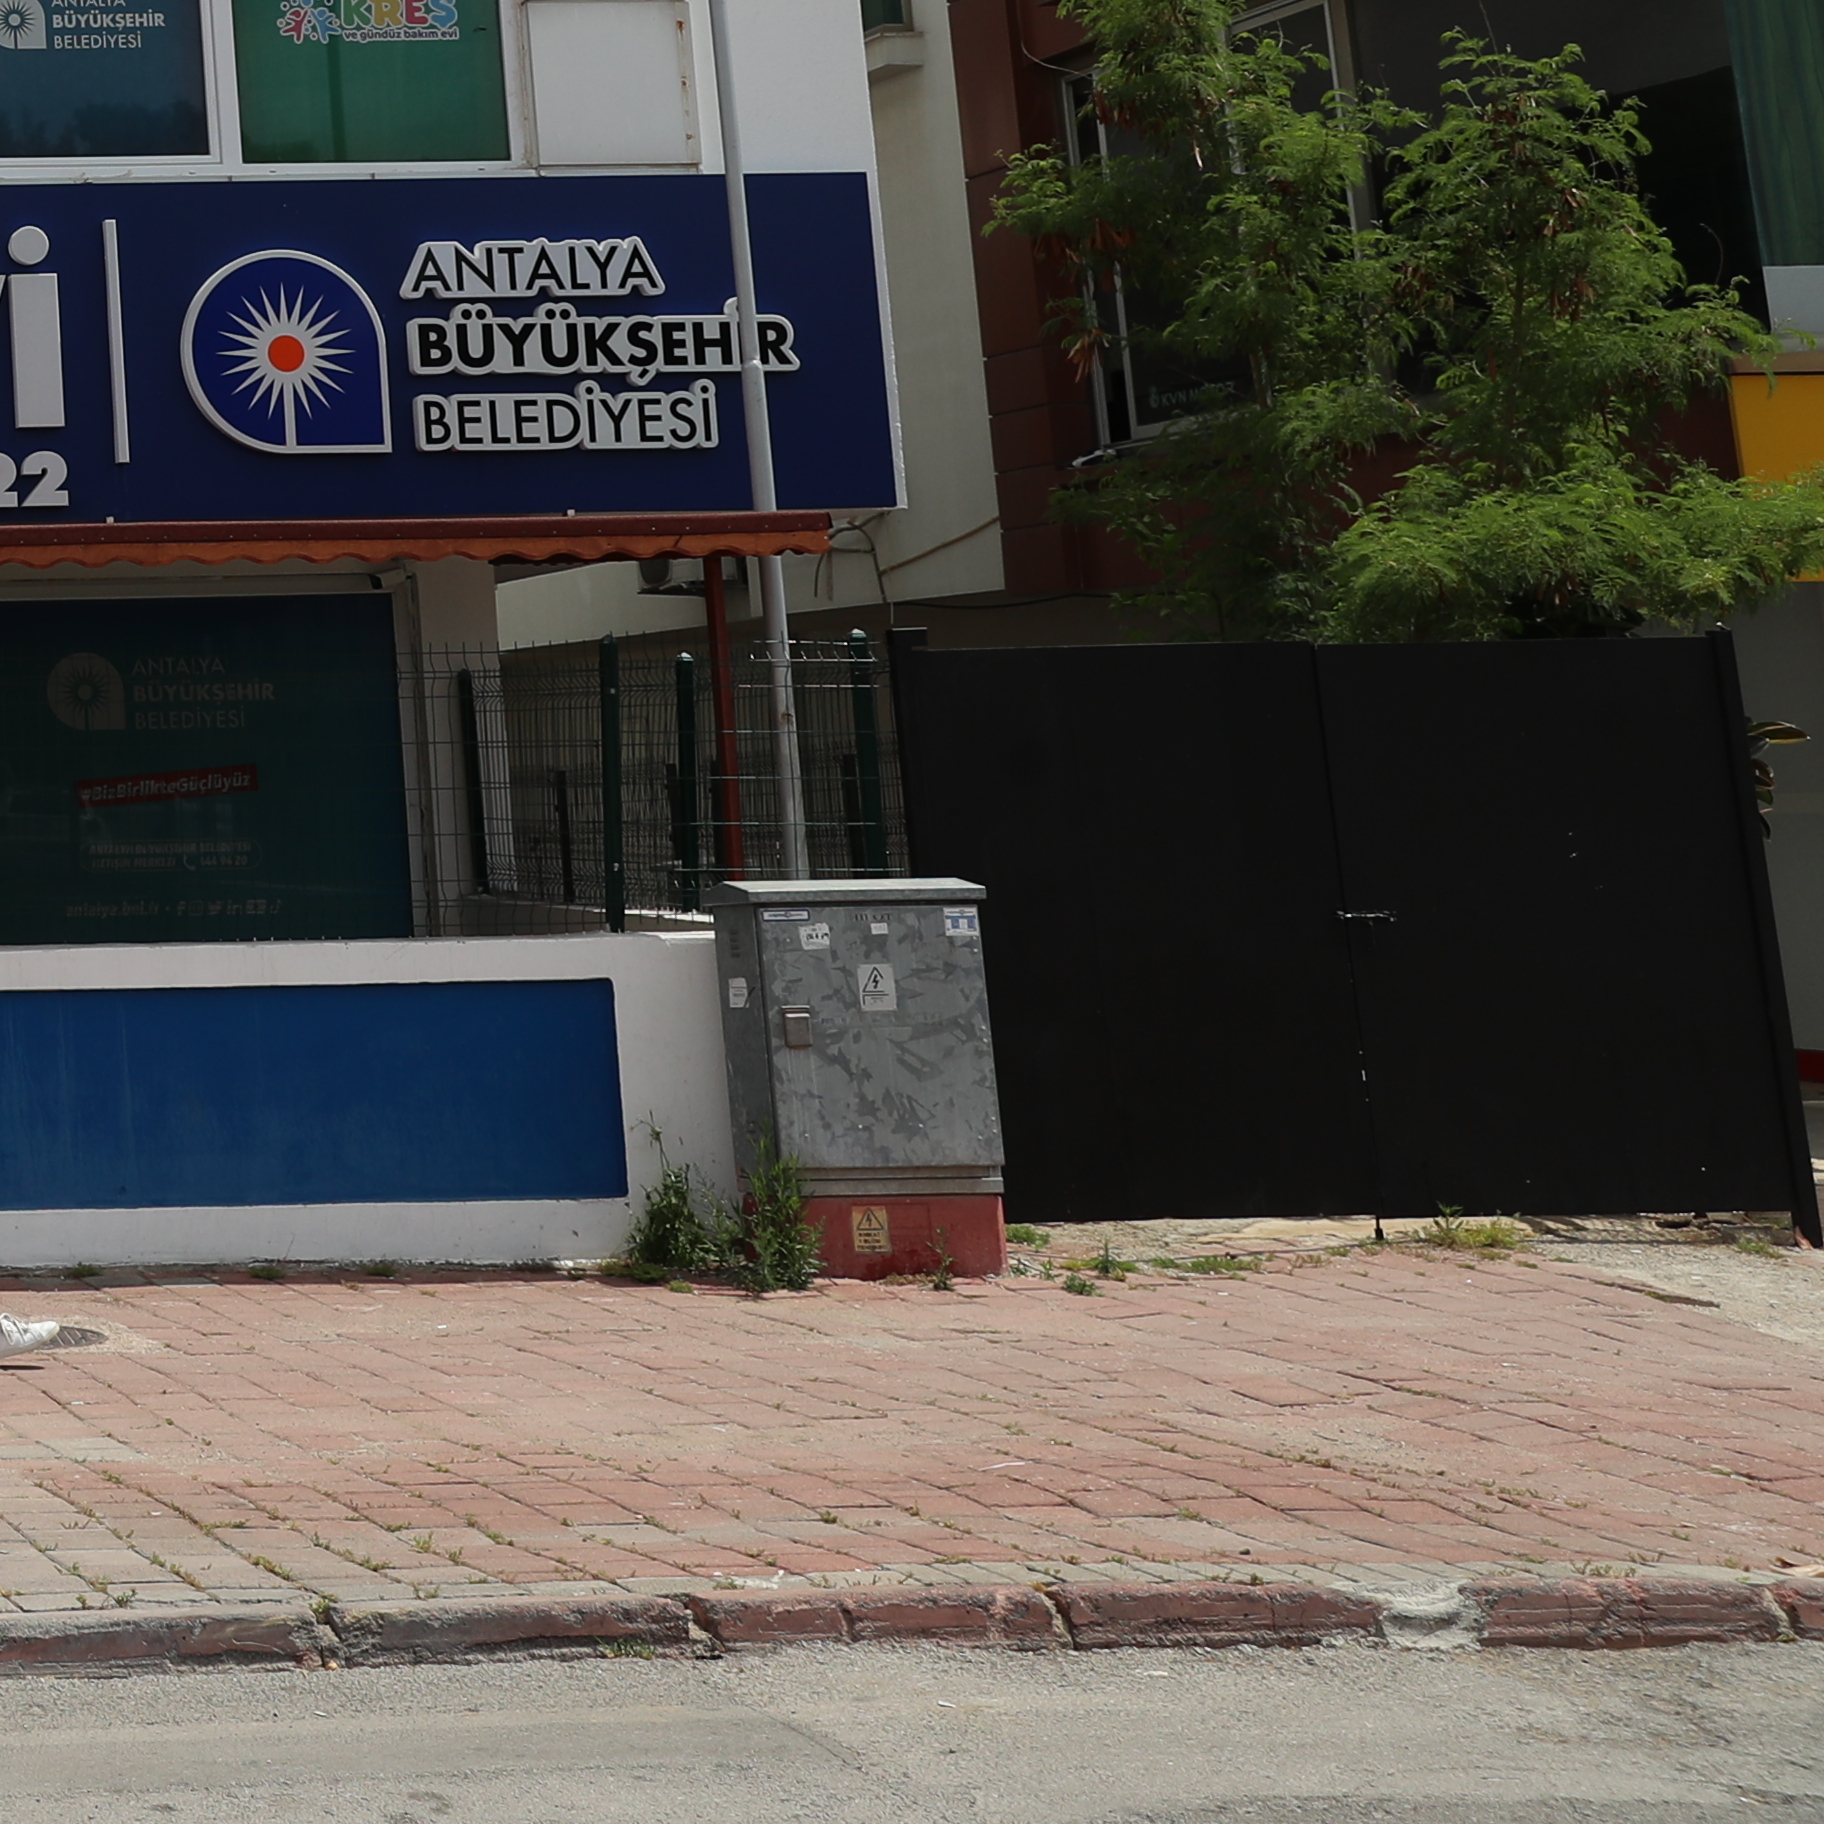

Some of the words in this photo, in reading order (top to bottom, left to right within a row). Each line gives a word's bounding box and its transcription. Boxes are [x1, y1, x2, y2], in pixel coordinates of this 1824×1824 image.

[53, 9, 166, 31] BÜYÜKŞEHİR
[54, 31, 141, 49] BELEDİYESİ
[344, 31, 358, 39] ve
[360, 29, 401, 41] gündüz
[404, 29, 438, 38] bakım
[441, 28, 457, 38] evi
[408, 242, 661, 295] ANTALYA
[418, 306, 794, 382] BÜYÜKŞEHR
[421, 382, 715, 447] BELEDİYESİ
[132, 657, 225, 675] ANTALYA
[133, 678, 275, 704] BÜYÜKŞEHİR
[135, 706, 245, 729] BELEDİYESİ
